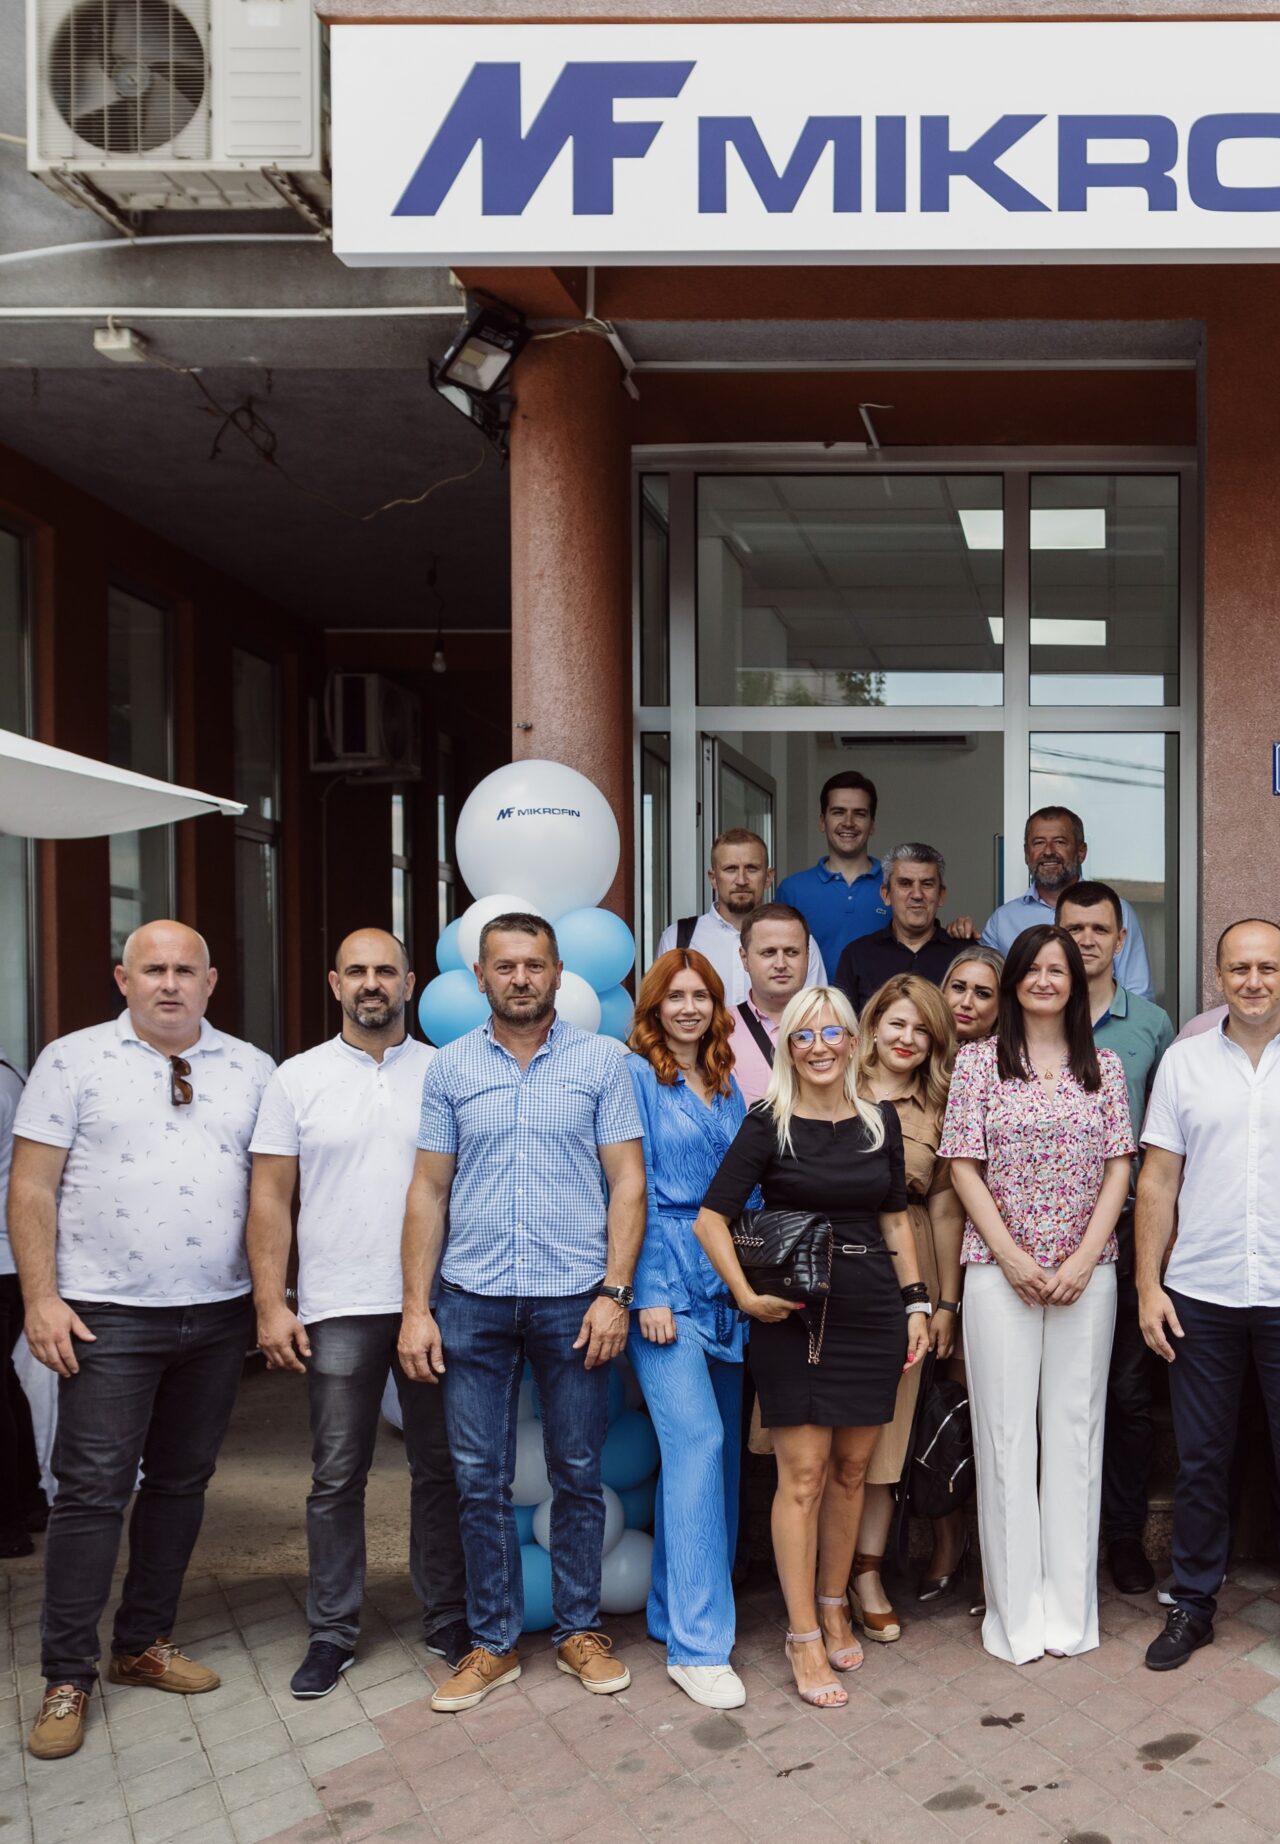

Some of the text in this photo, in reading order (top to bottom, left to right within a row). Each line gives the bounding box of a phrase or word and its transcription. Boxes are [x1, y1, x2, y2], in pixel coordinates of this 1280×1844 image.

[391, 60, 699, 217] MF
[497, 807, 581, 821] MF MIKROFIN
